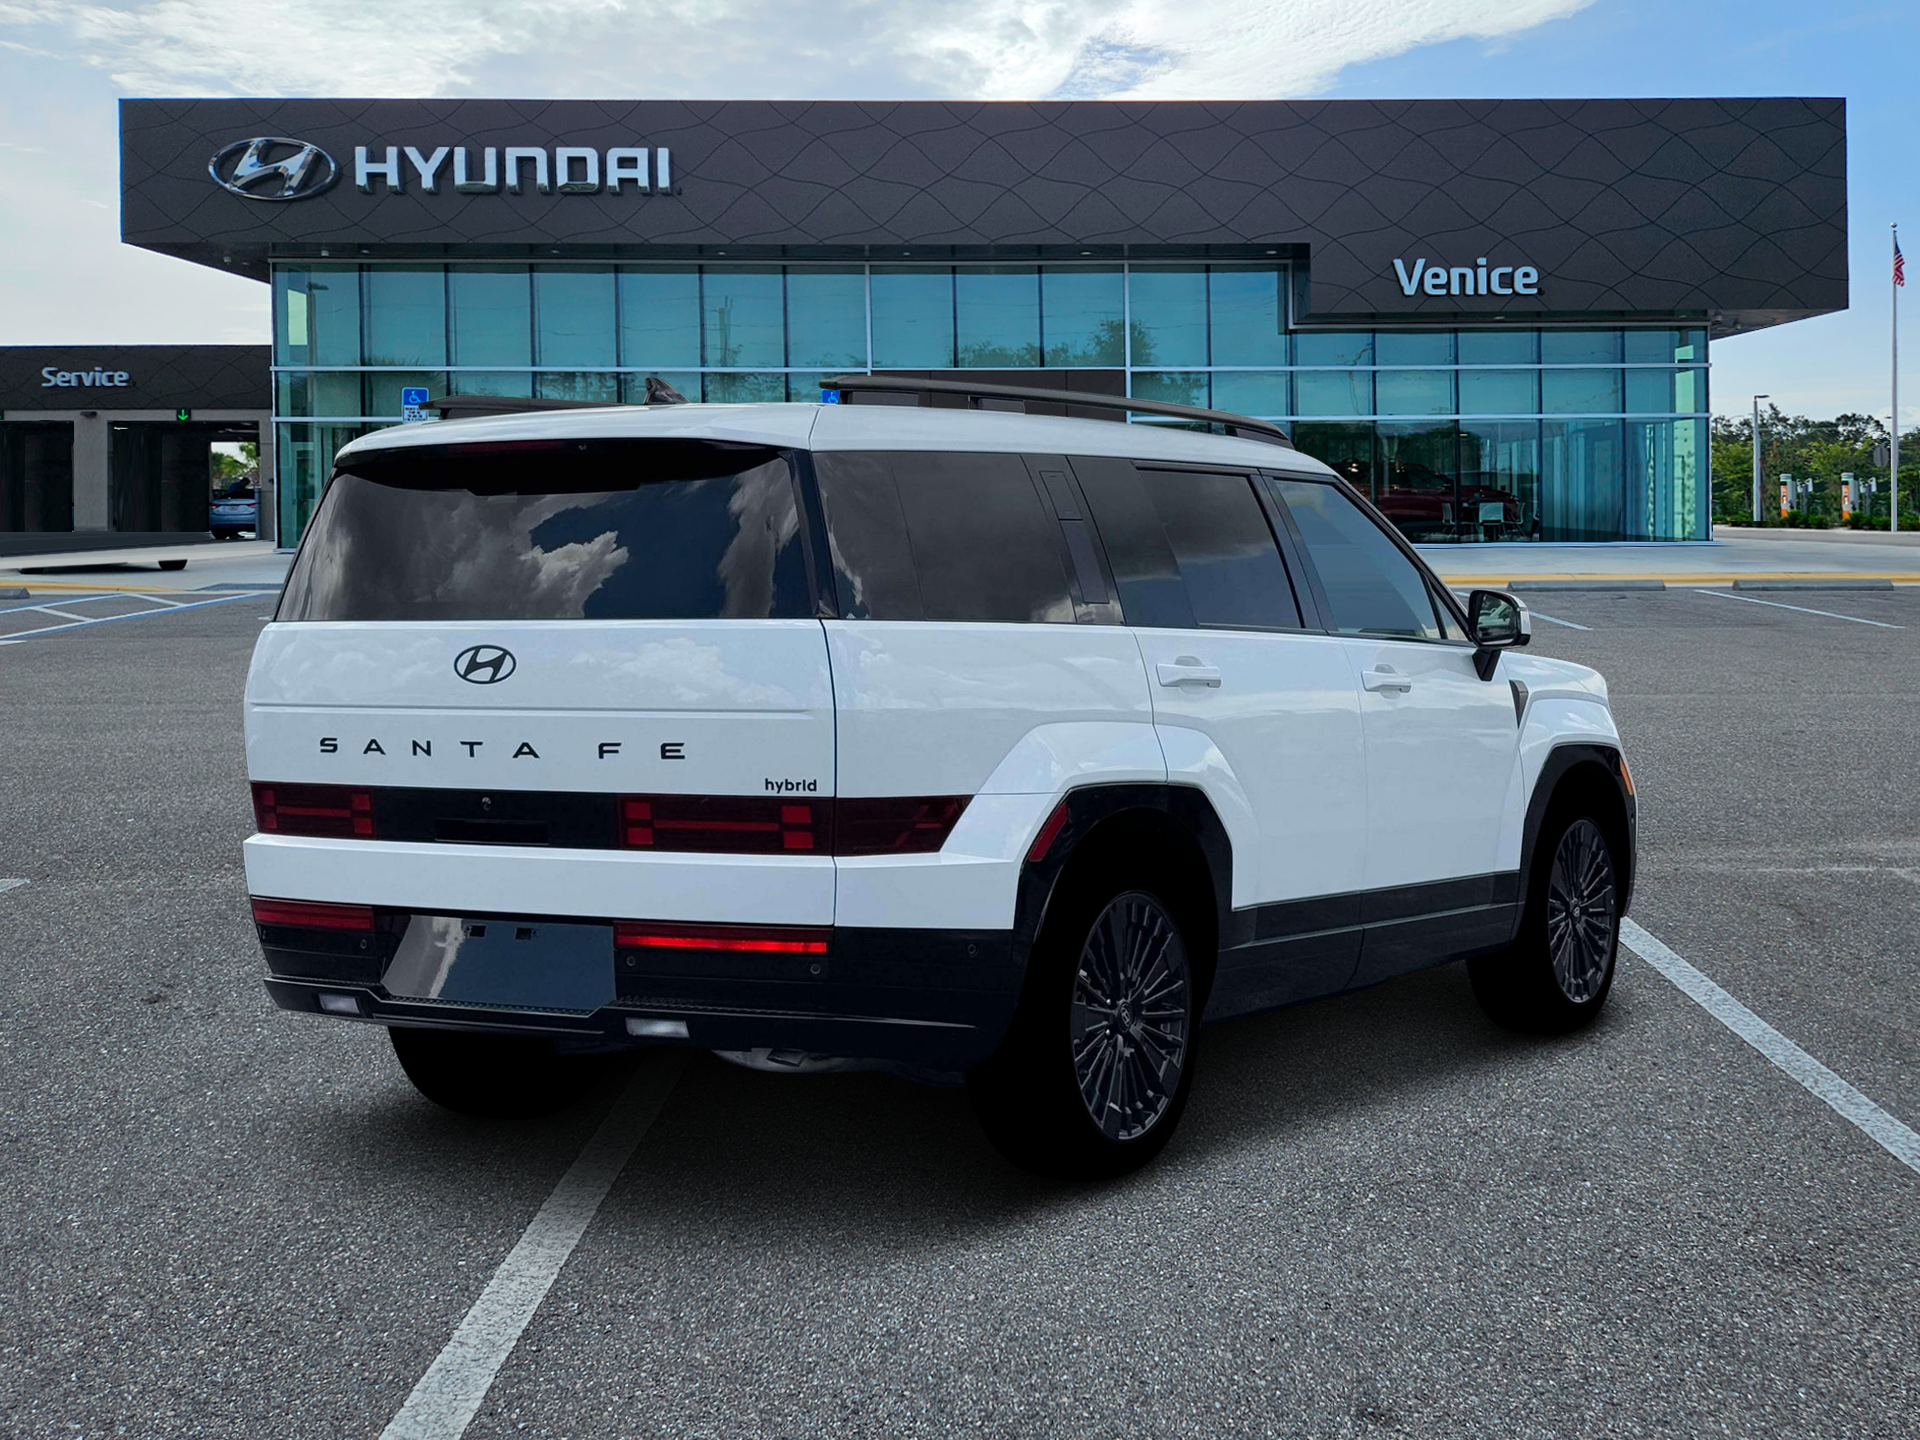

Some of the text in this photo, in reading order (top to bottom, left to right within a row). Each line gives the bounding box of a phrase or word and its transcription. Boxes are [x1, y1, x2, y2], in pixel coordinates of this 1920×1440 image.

[354, 146, 671, 194] HYUNDAI
[1393, 257, 1539, 295] Venice
[41, 366, 130, 387] Service
[320, 737, 686, 760] SANTA FE
[765, 778, 817, 794] hybrid
